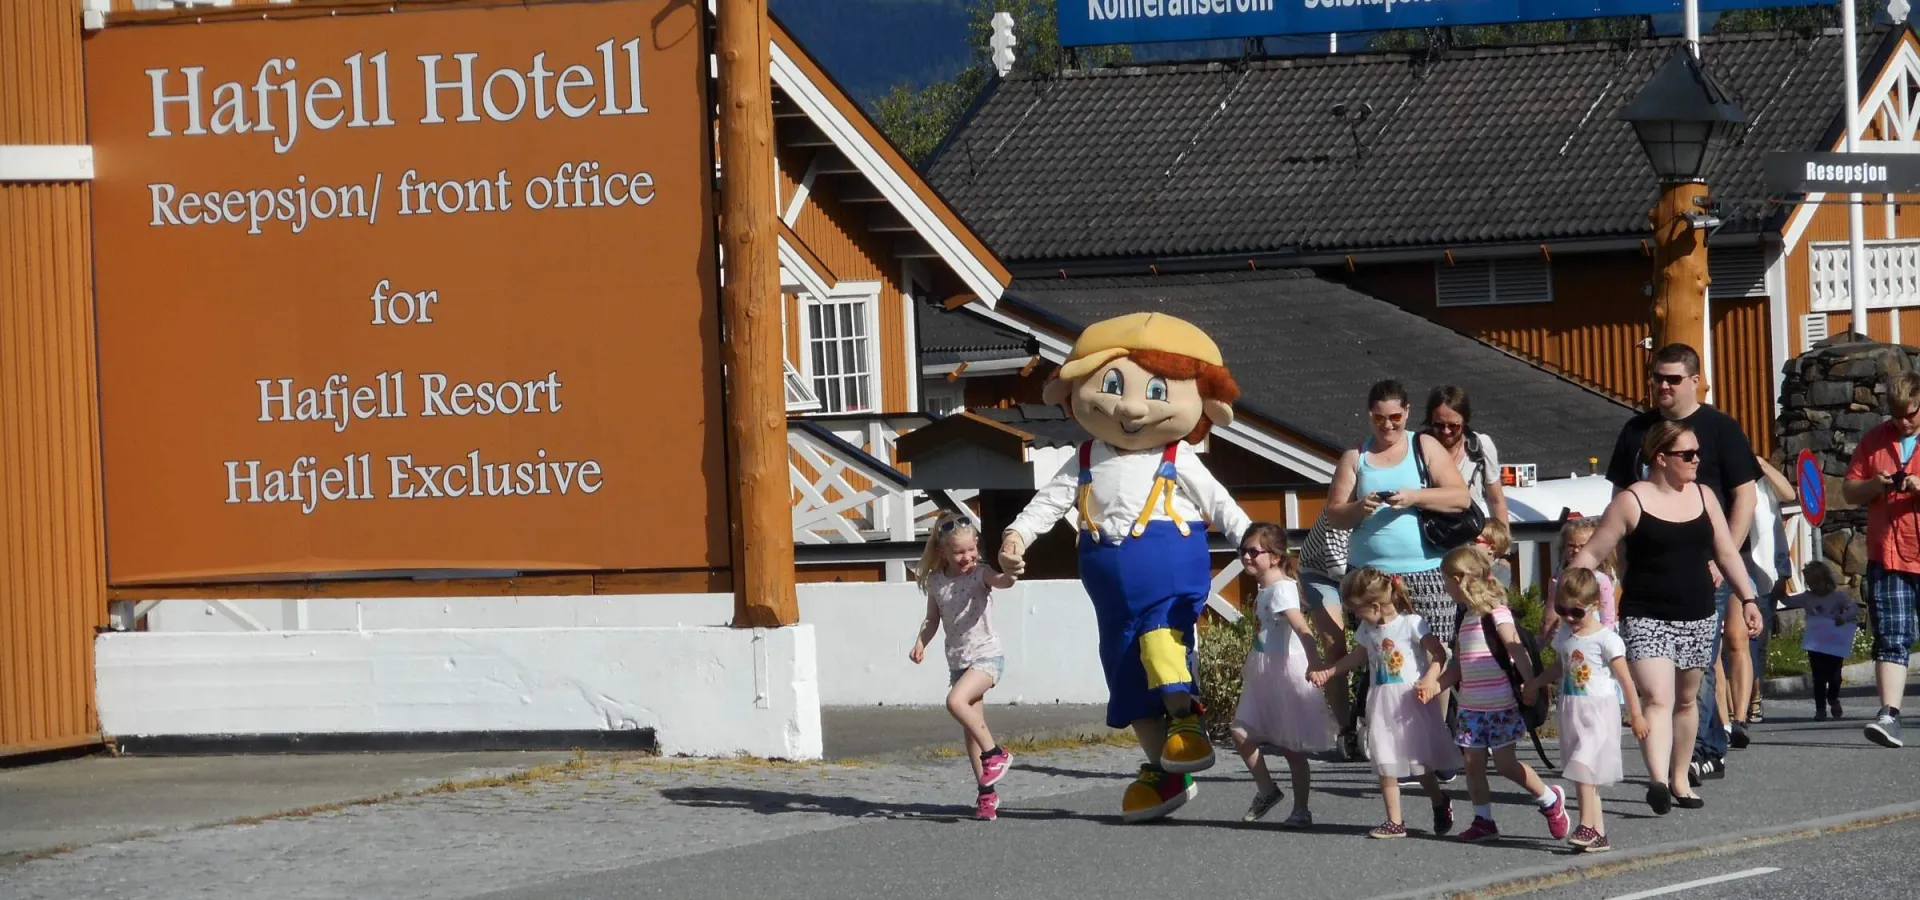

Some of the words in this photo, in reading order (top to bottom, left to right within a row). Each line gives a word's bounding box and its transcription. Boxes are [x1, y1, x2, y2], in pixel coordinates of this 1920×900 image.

[145, 51, 395, 154] Hafjell
[417, 37, 649, 124] Hotell
[147, 173, 382, 235] Resepsjon/
[397, 169, 512, 215] front
[525, 161, 655, 210] office
[1806, 161, 1887, 184] Resepsjon
[370, 279, 438, 325] for
[256, 371, 407, 433] Hafjell
[419, 371, 562, 416] Resort
[223, 453, 375, 515] Hafjell
[386, 449, 603, 499] Exclusive
